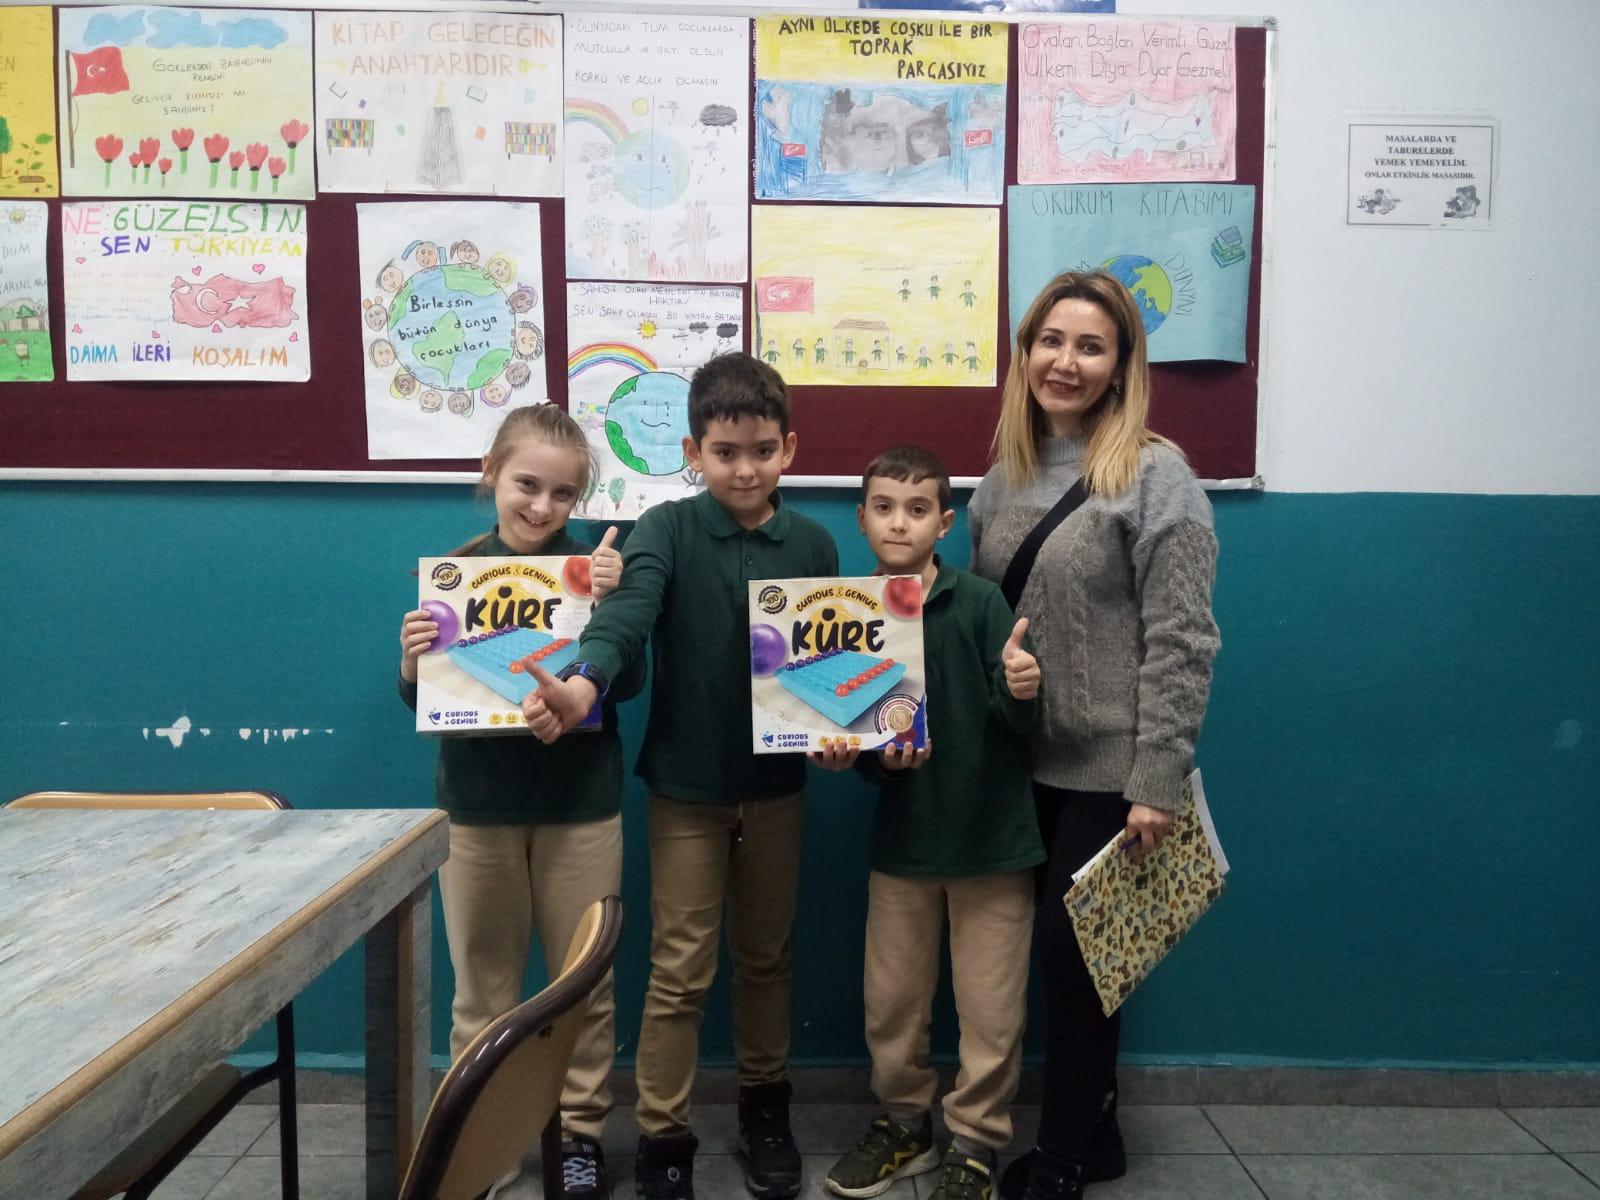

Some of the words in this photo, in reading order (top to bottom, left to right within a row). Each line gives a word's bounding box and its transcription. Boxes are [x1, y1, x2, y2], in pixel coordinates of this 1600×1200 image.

[778, 17, 815, 35] AYNI
[824, 17, 881, 35] ÜLKEDE
[939, 20, 961, 37] İLE
[969, 23, 993, 39] BİR
[848, 37, 914, 56] TOPRAK
[350, 52, 515, 76] ANAHTARIDIR
[1385, 135, 1442, 143] MASALARDA
[1444, 135, 1457, 144] VE
[1388, 146, 1455, 155] TABURELERDE
[1374, 158, 1407, 167] YEMEK
[1031, 189, 1113, 216] OKURUM
[63, 208, 101, 235] NE
[101, 235, 151, 257] SEN
[398, 326, 437, 341] bütün
[132, 341, 171, 362] İLERİ
[471, 566, 511, 589] CURIOUS
[522, 567, 556, 589] GENIUS
[796, 588, 834, 612] CURIOUS
[845, 589, 878, 610] GENIUS
[792, 607, 885, 656] KÜRE
